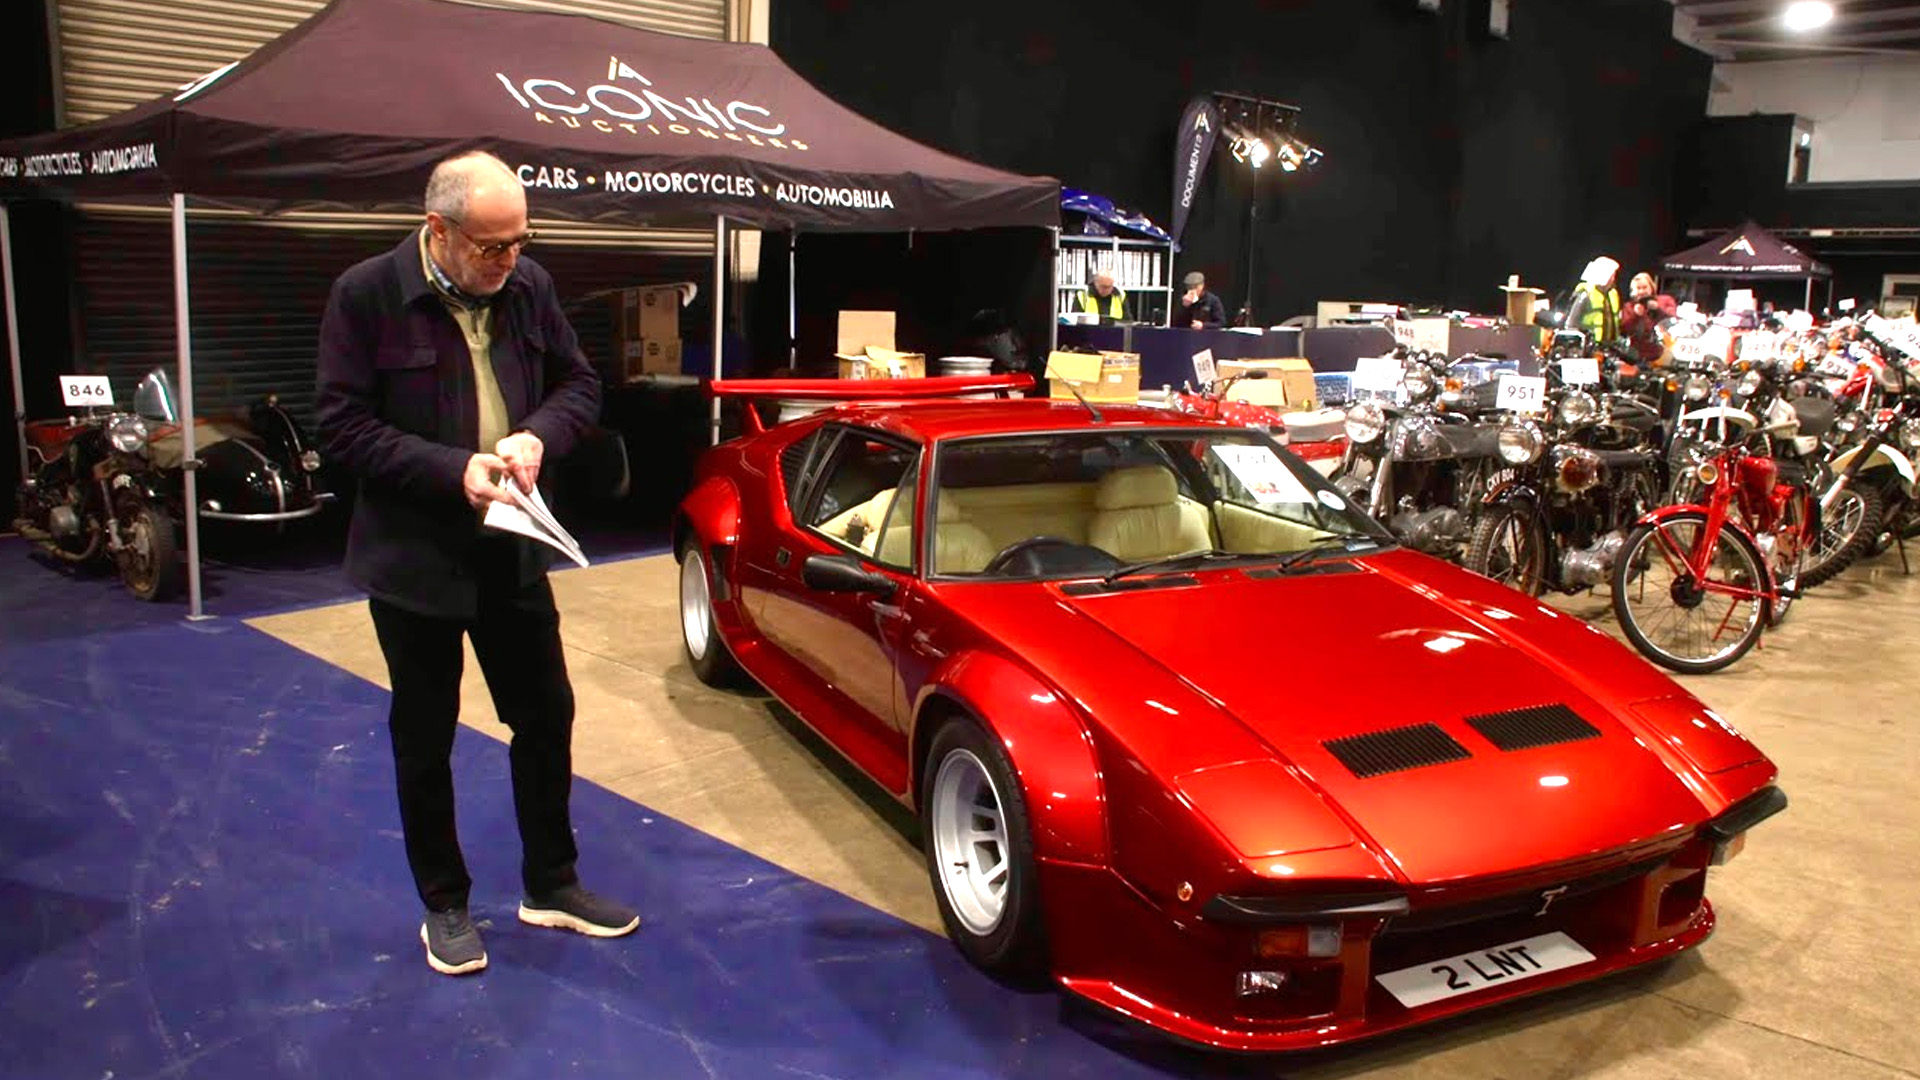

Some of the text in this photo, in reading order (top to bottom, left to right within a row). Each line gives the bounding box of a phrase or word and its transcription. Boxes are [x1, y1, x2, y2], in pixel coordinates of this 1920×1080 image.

[496, 72, 785, 135] ICONIC
[535, 111, 809, 151] AUCTIONEERS
[516, 164, 894, 209] CARS MOTORCYCLES AUTOMOBILIA
[1181, 133, 1203, 208] DOCUMENTS
[69, 384, 105, 397] 846
[1508, 385, 1535, 400] 951
[1431, 945, 1542, 990] 2 LNT
